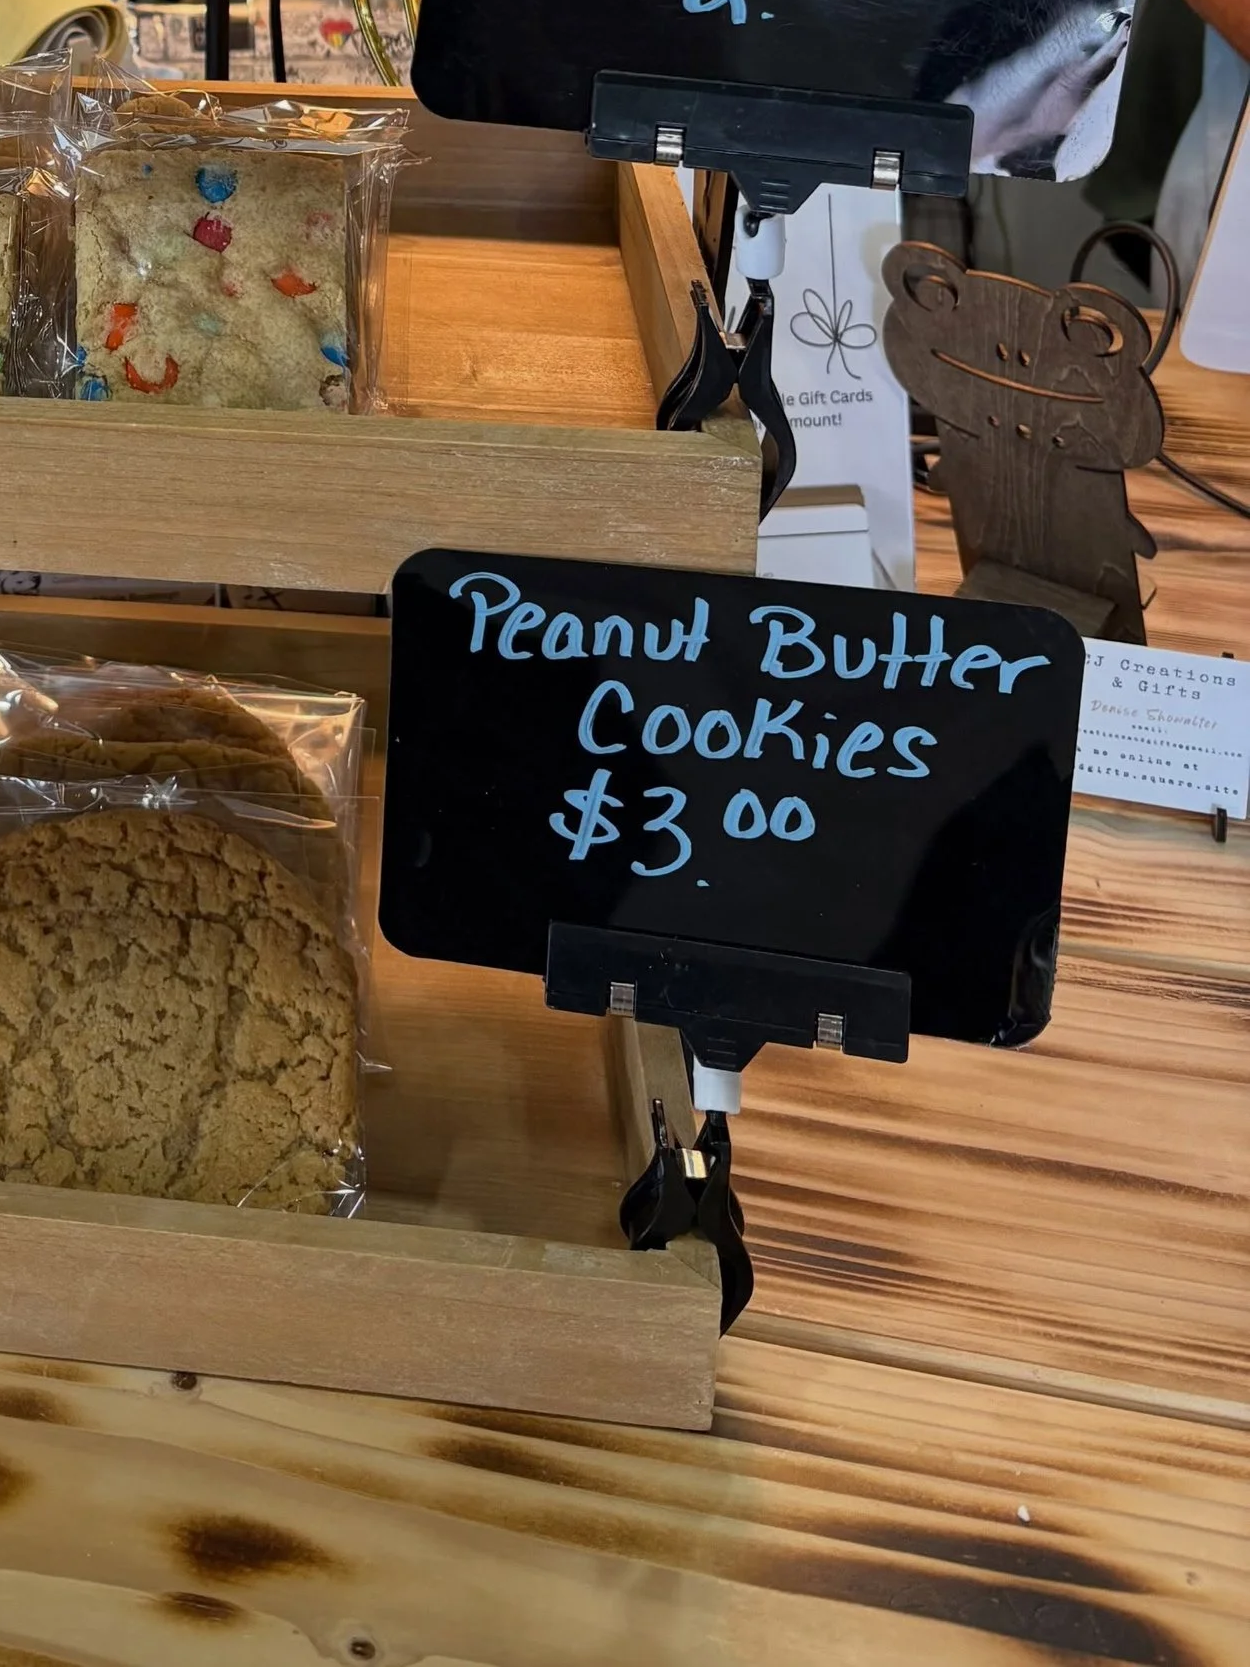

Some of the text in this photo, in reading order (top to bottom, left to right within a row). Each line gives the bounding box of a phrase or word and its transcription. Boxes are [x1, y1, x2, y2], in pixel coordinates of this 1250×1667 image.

[799, 391, 827, 406] Gift
[829, 387, 874, 405] Cards
[789, 413, 842, 428] mount!
[448, 572, 1050, 695] Peanut Butter
[1120, 659, 1236, 687] Creations
[1111, 676, 1201, 700] & Gifts
[578, 679, 938, 780] Cookies
[1090, 700, 1218, 730] Denise Showalter
[1120, 752, 1171, 767] online
[1183, 762, 1199, 772] at
[1077, 762, 1239, 796] dgifts.square.site
[550, 768, 817, 889] $3.00
